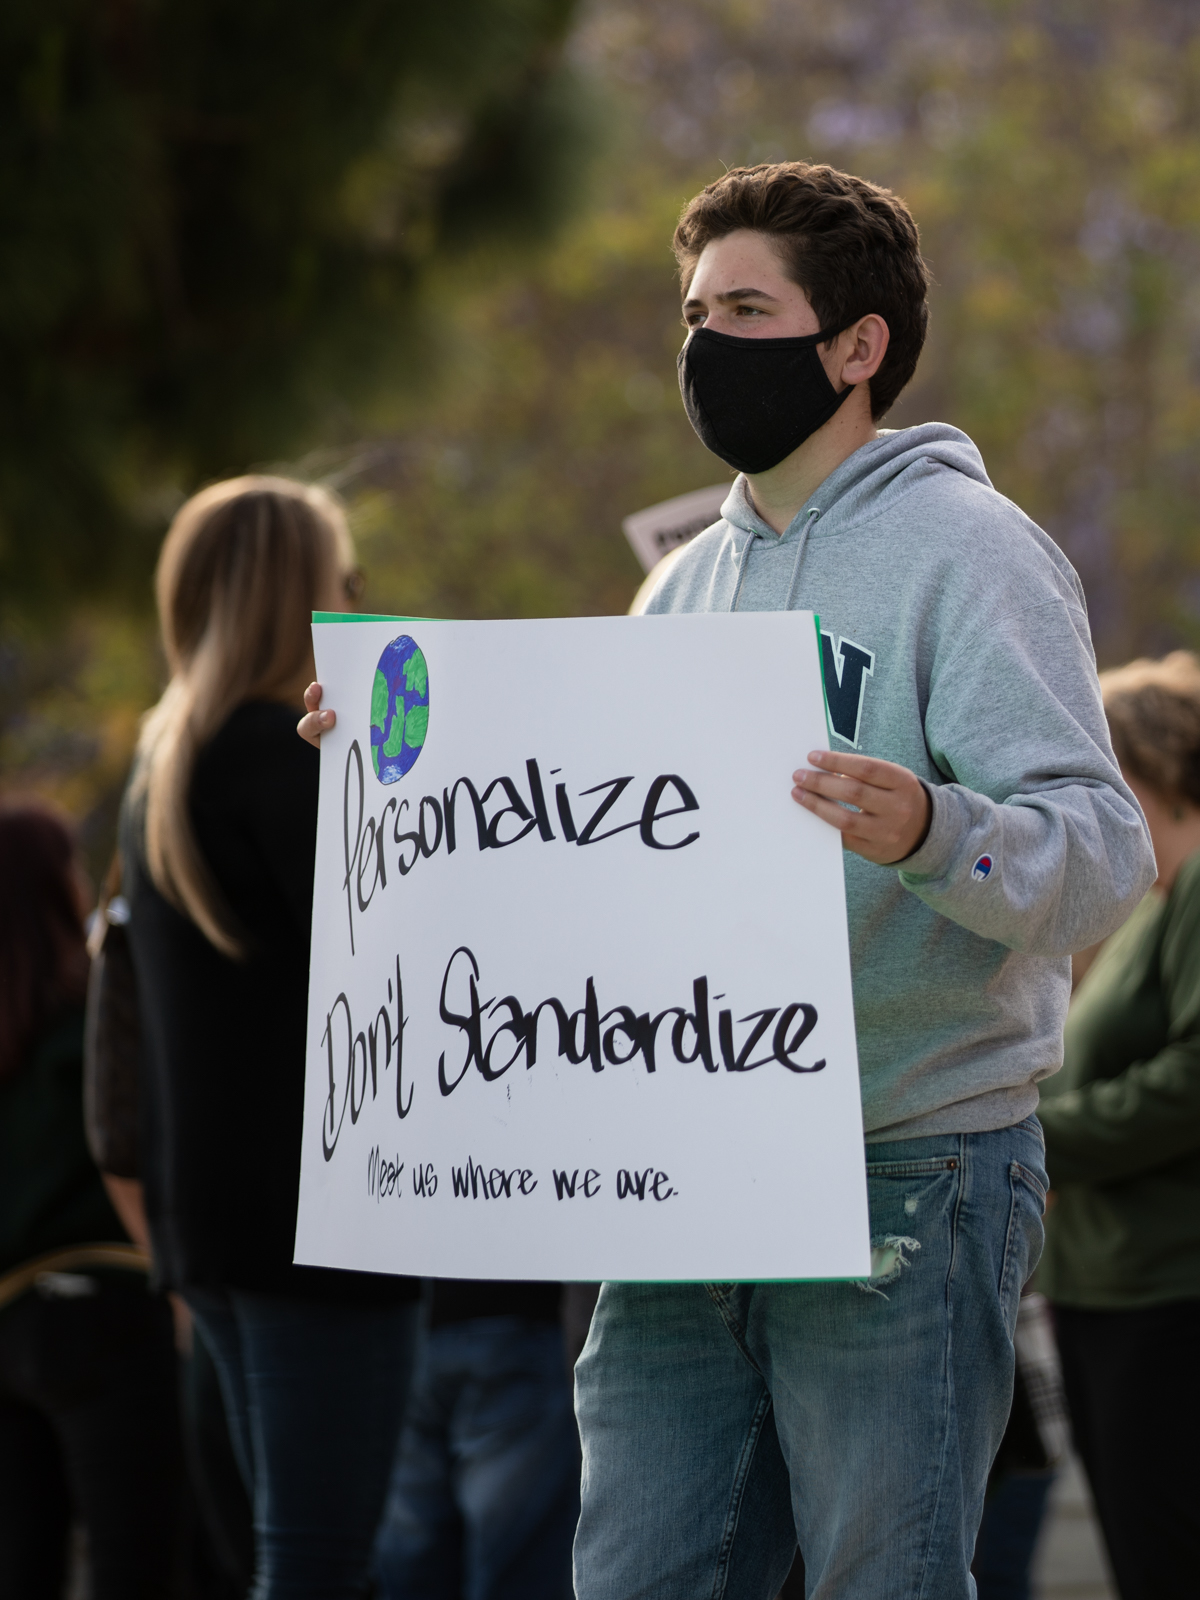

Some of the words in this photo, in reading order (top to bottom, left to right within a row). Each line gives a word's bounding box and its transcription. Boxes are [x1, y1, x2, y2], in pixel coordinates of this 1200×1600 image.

[343, 739, 700, 956] Personalize
[320, 953, 415, 1162] Don't
[437, 946, 827, 1096] Standardize
[367, 1144, 404, 1204] Meet
[412, 1162, 438, 1198] us
[451, 1154, 538, 1200] where
[552, 1167, 601, 1201] we
[616, 1167, 679, 1202] are.
